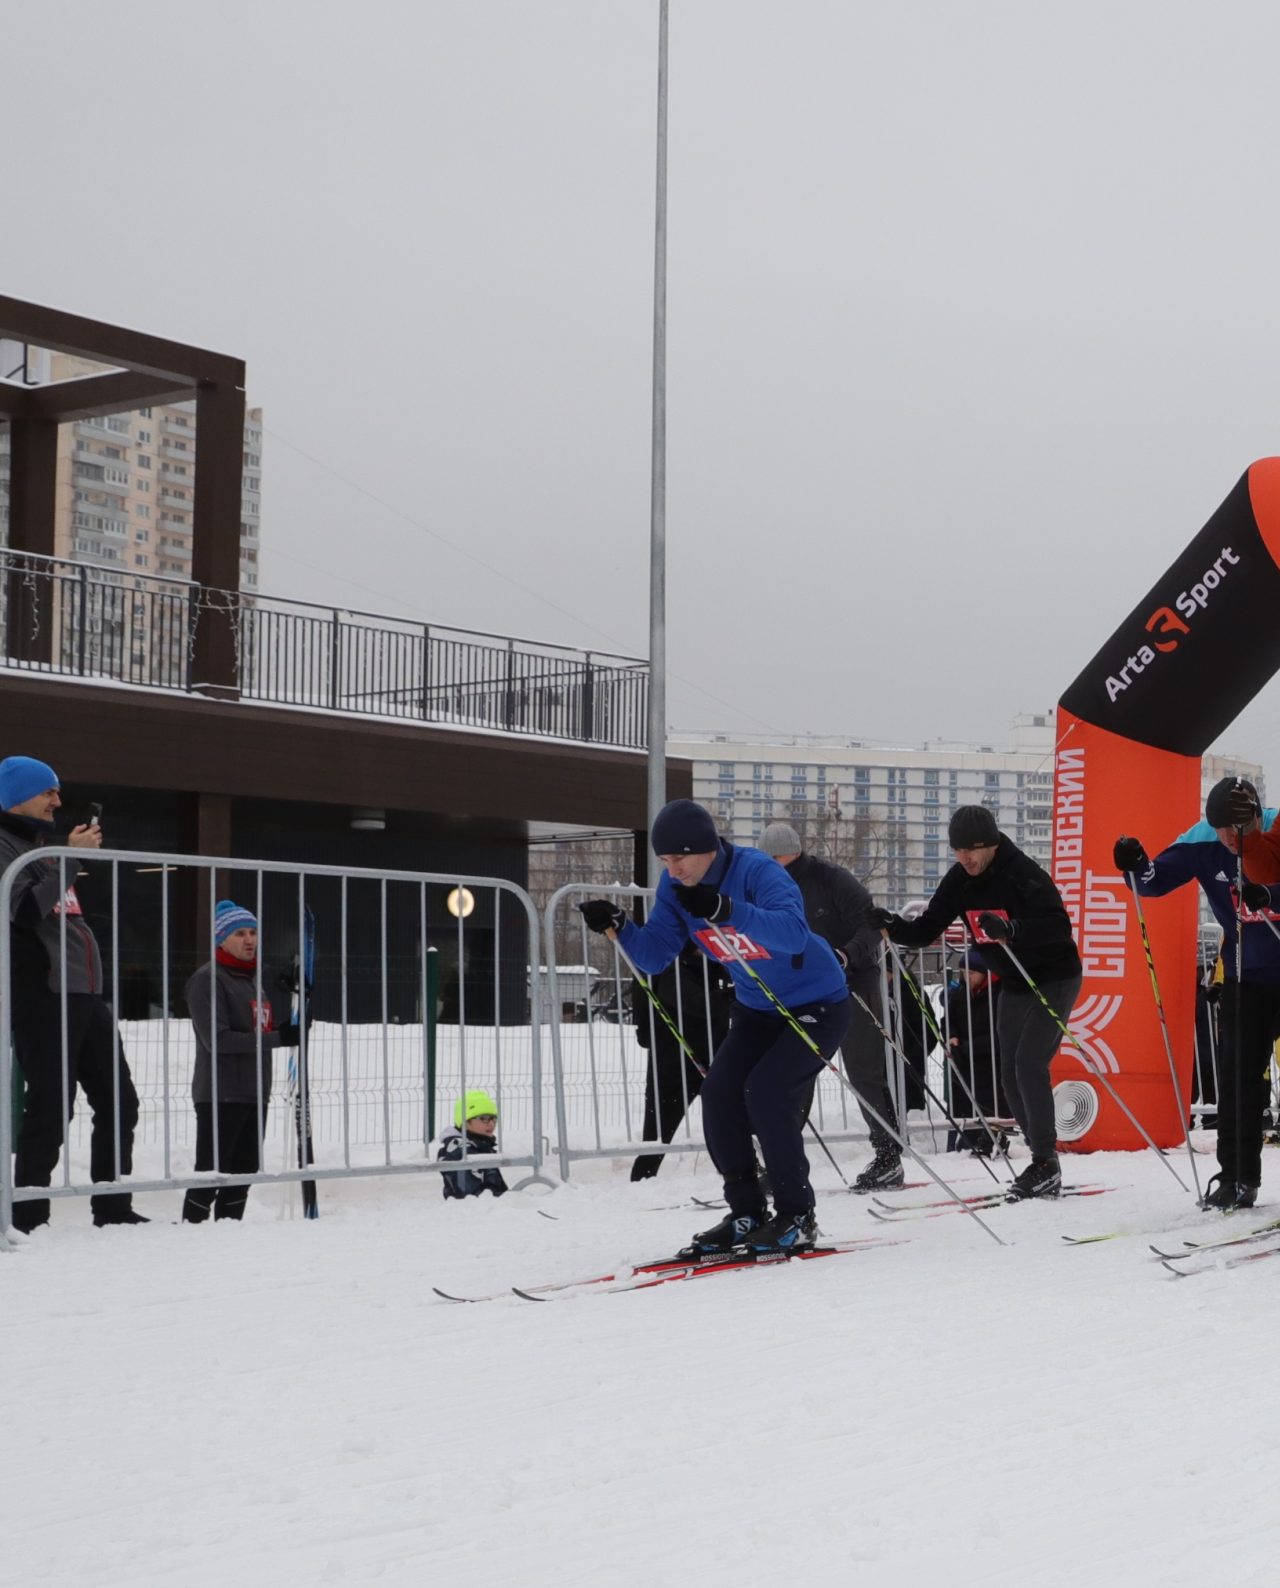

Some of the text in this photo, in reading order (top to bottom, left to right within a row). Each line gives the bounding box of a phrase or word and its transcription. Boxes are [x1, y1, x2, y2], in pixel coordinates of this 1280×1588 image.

[1104, 546, 1241, 703] Arta Sport
[708, 933, 760, 956] 121
[1082, 869, 1127, 978] СПОРТ
